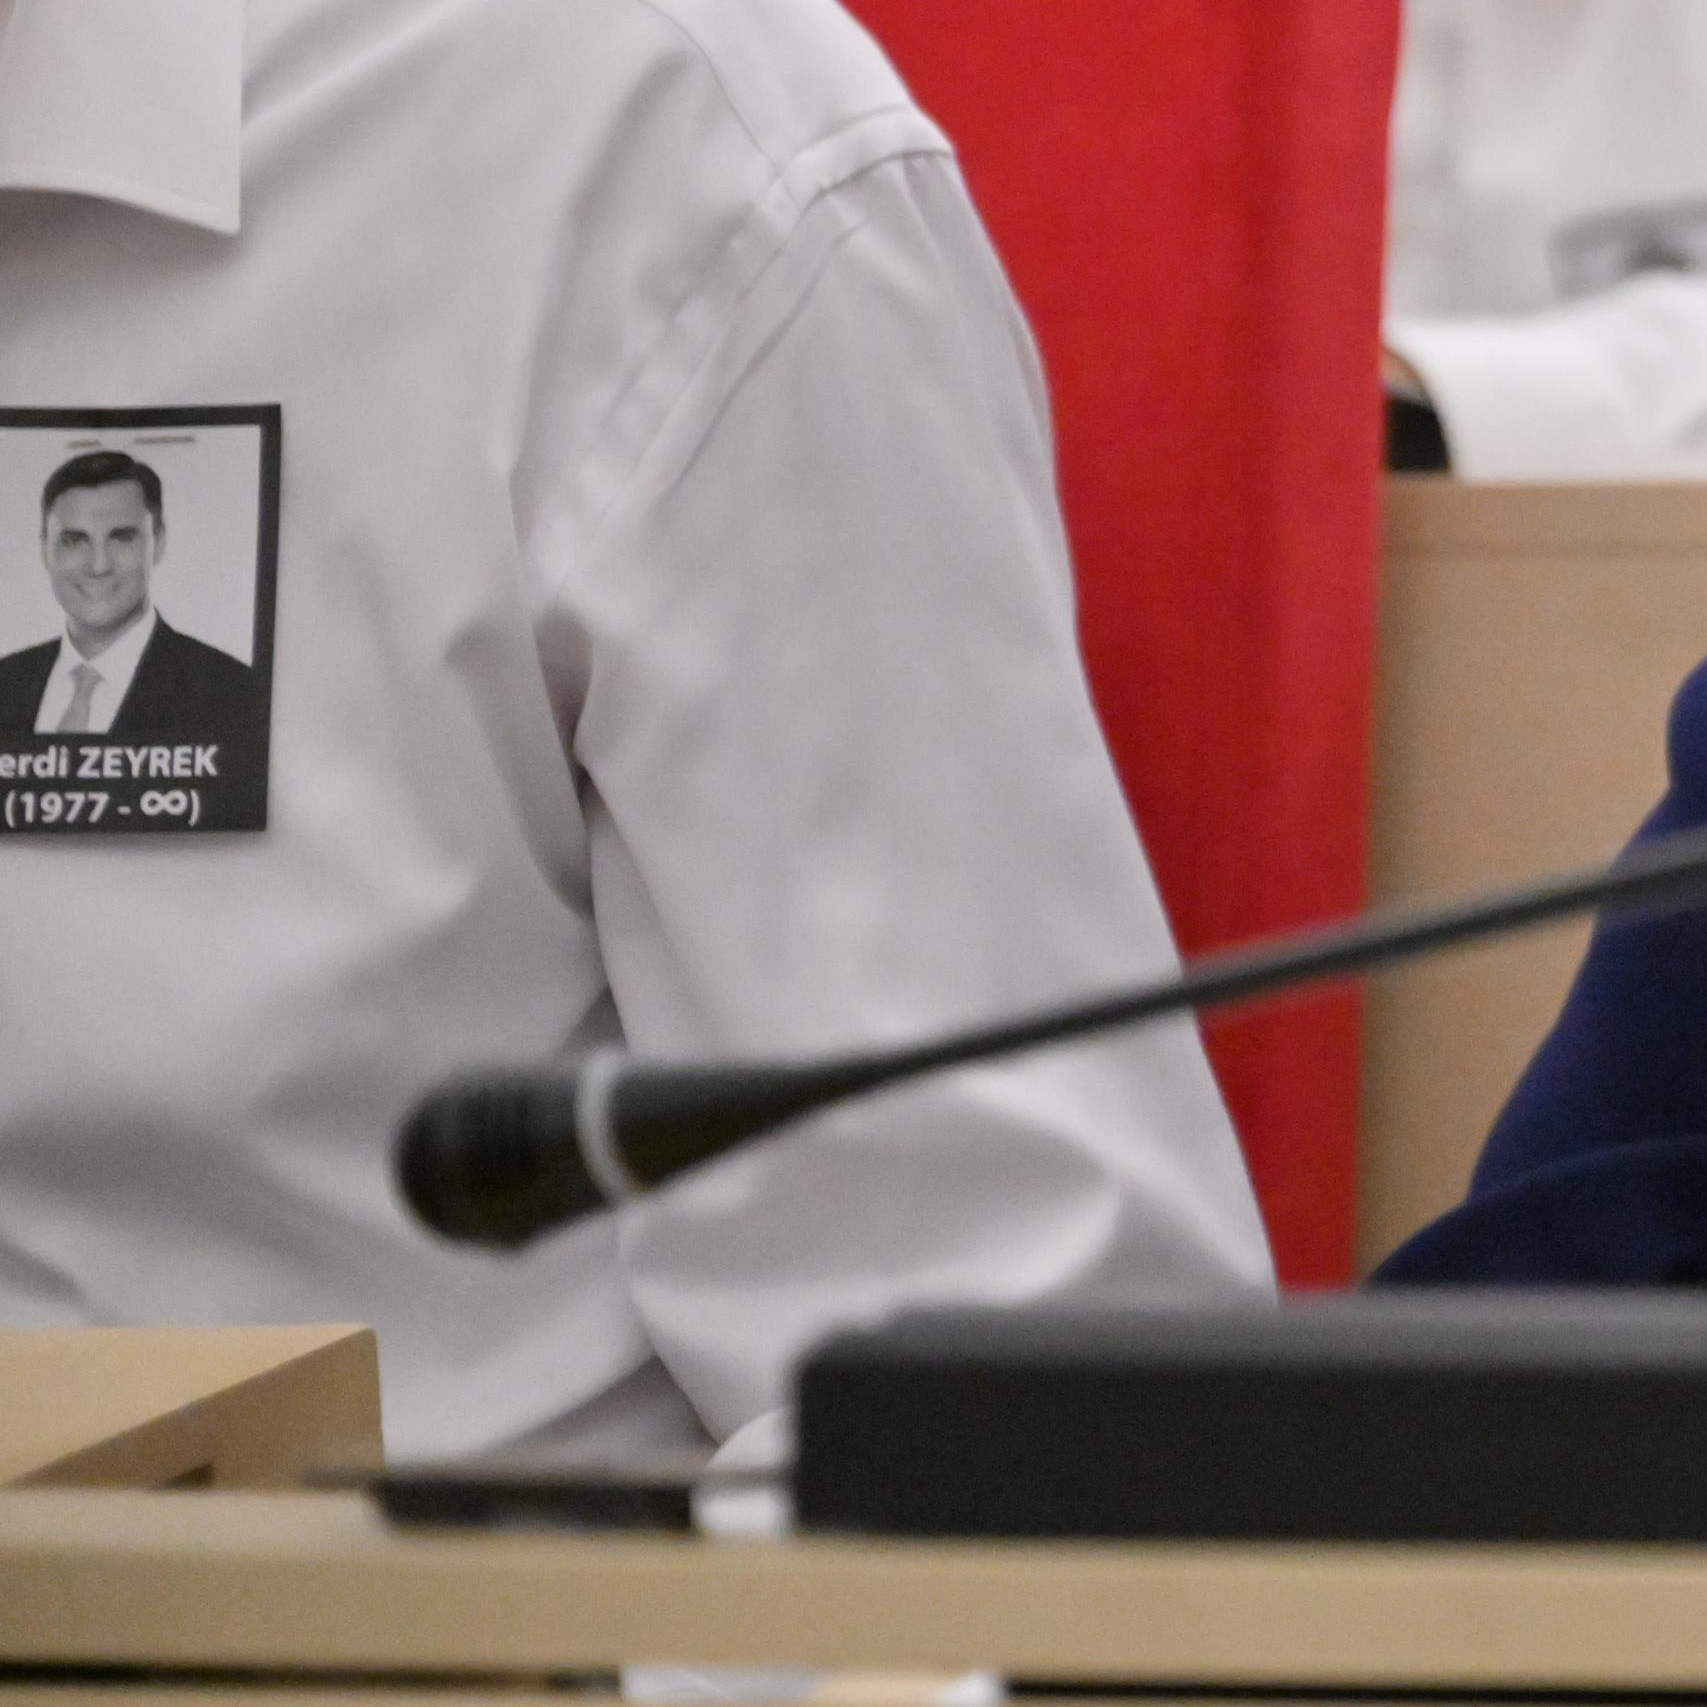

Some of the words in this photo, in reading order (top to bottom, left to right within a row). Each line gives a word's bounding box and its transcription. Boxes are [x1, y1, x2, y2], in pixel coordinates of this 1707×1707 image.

[0, 745, 69, 779] erdi
[76, 745, 218, 779] ZEYREK
[5, 790, 110, 828] (1977
